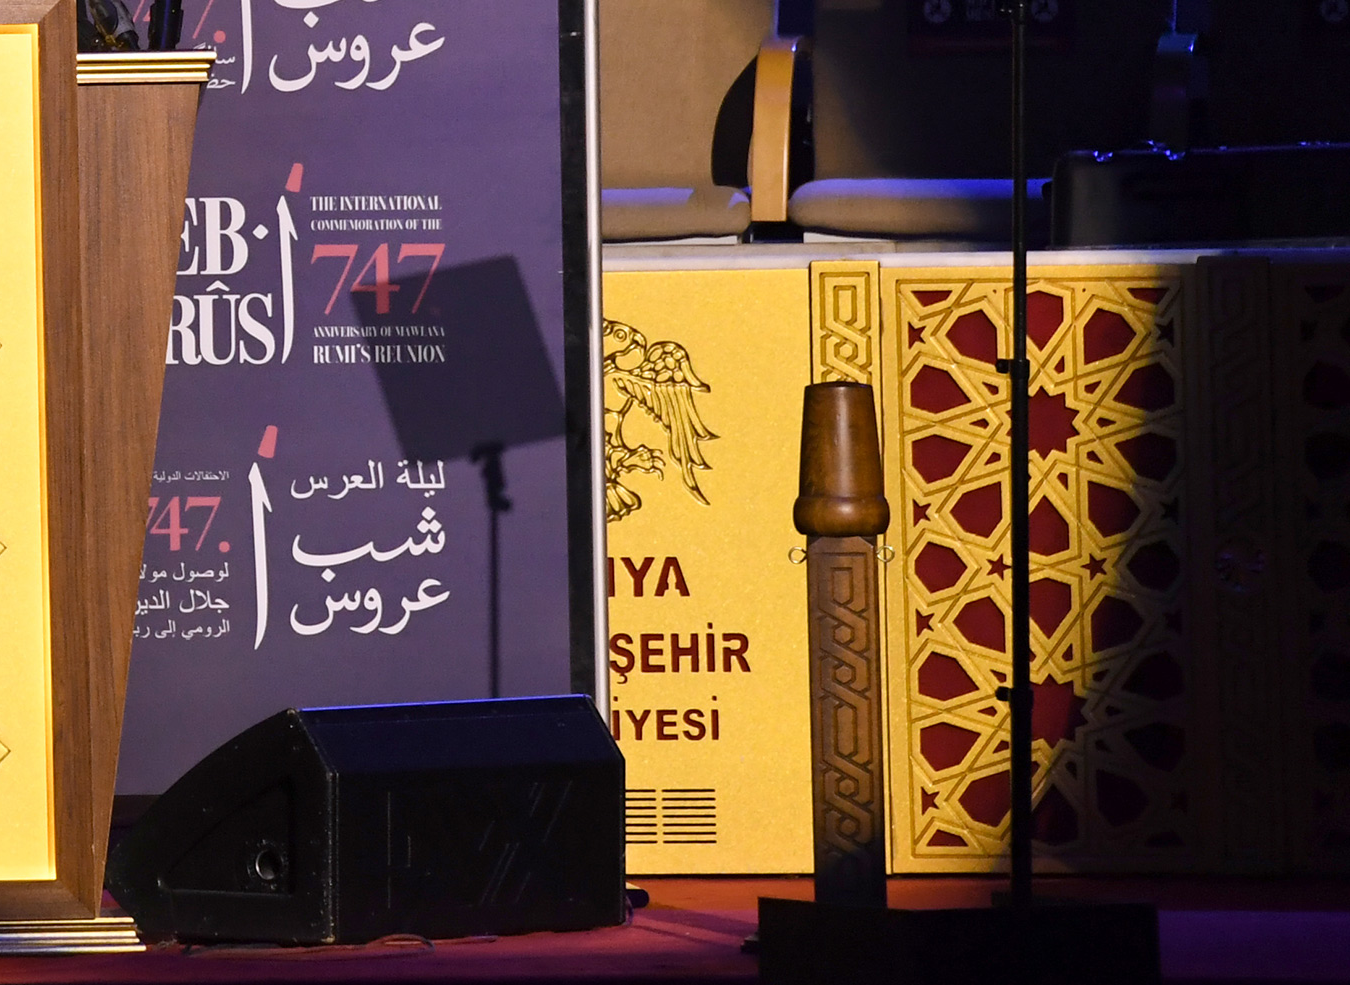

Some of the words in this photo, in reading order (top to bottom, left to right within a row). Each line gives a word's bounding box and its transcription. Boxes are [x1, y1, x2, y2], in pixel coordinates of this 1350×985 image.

[268, 22, 446, 93] عروس
[310, 195, 337, 211] THE
[340, 194, 442, 211] INTERNATIONAL
[310, 218, 404, 231] COMMEMORATION
[405, 218, 419, 230] OF
[421, 218, 443, 230] THE
[374, 344, 446, 363] REUNION
[290, 460, 384, 500] العرس
[396, 460, 446, 498] ليلة
[292, 507, 446, 583] شب
[179, 588, 230, 613] جلال
[290, 578, 450, 635] عروس
